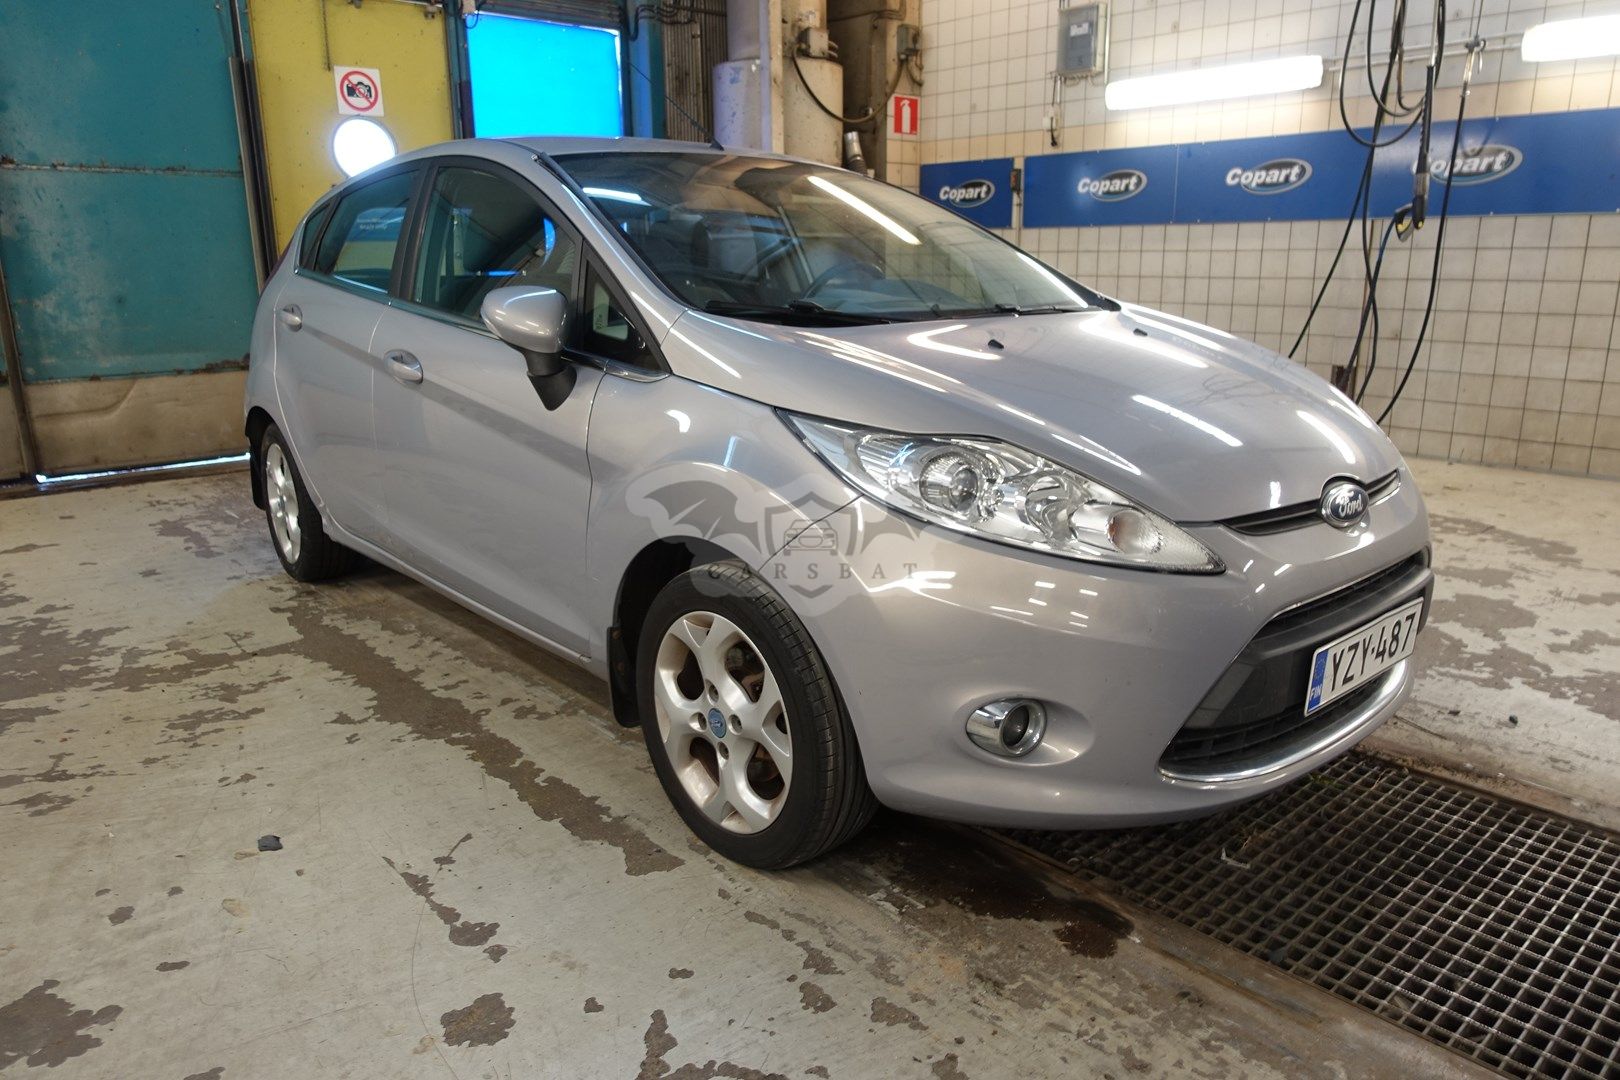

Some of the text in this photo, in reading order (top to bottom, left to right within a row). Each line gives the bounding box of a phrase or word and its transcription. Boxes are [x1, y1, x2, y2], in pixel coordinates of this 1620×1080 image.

[1077, 173, 1138, 195] Copart
[1226, 165, 1300, 188] Copart
[939, 185, 988, 201] Copart
[1335, 487, 1363, 517] Ford
[1331, 612, 1417, 692] YZY-487
